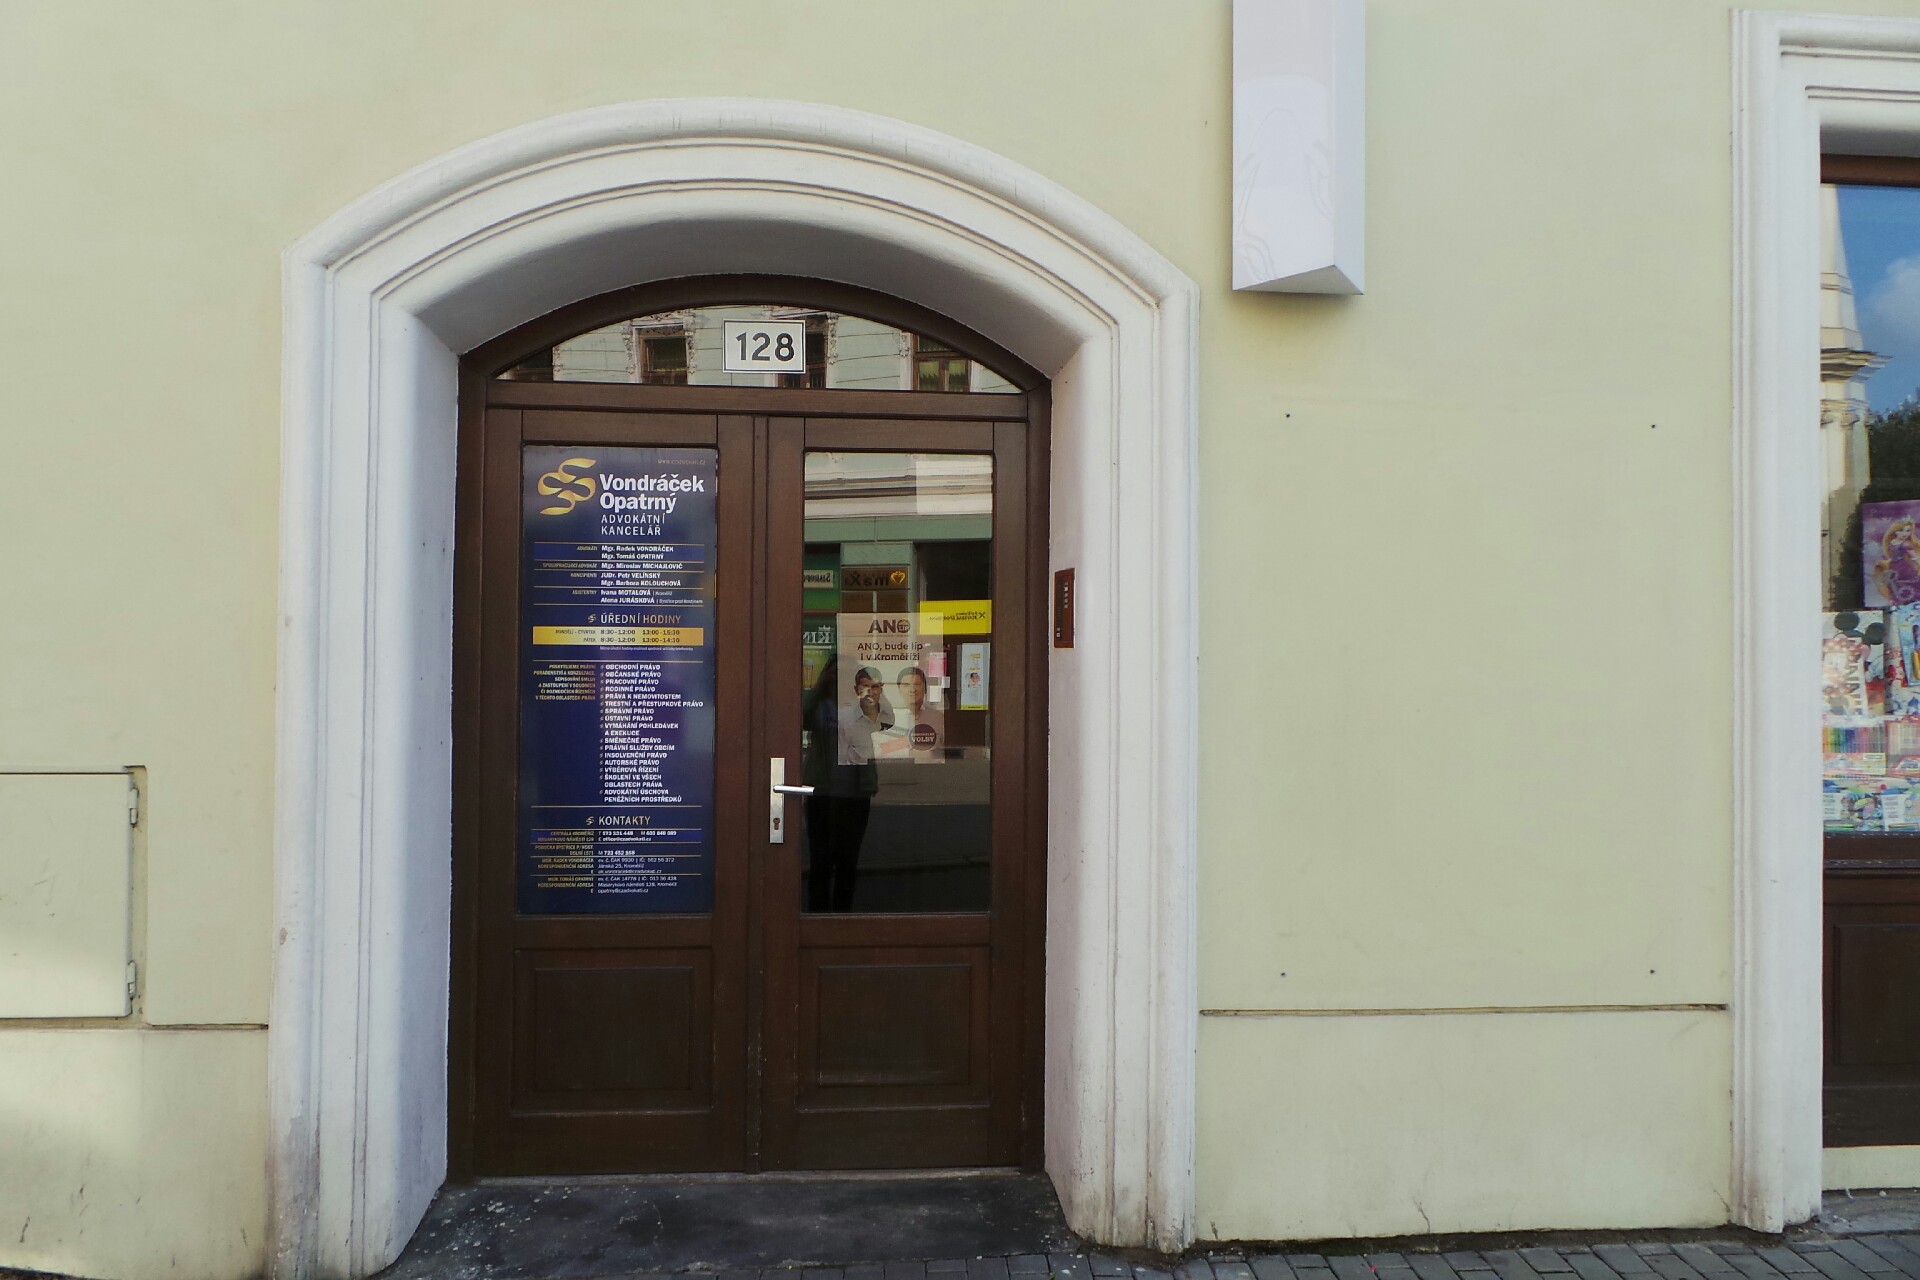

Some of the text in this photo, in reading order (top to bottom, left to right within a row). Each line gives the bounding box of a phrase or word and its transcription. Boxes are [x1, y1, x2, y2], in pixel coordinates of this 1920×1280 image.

[736, 332, 795, 362] 128
[600, 474, 704, 492] Vondráček
[600, 493, 676, 513] Opatrný
[601, 513, 665, 524] ADVOKÁTNÍ
[602, 524, 661, 535] KANCELÁŘ
[601, 612, 681, 624] ÚŘEDNÍ HODINY
[868, 619, 910, 634] ANO
[858, 642, 923, 651] ANO, bude líp
[874, 652, 920, 661] Kroměříži
[599, 816, 650, 826] KONTAKTY
